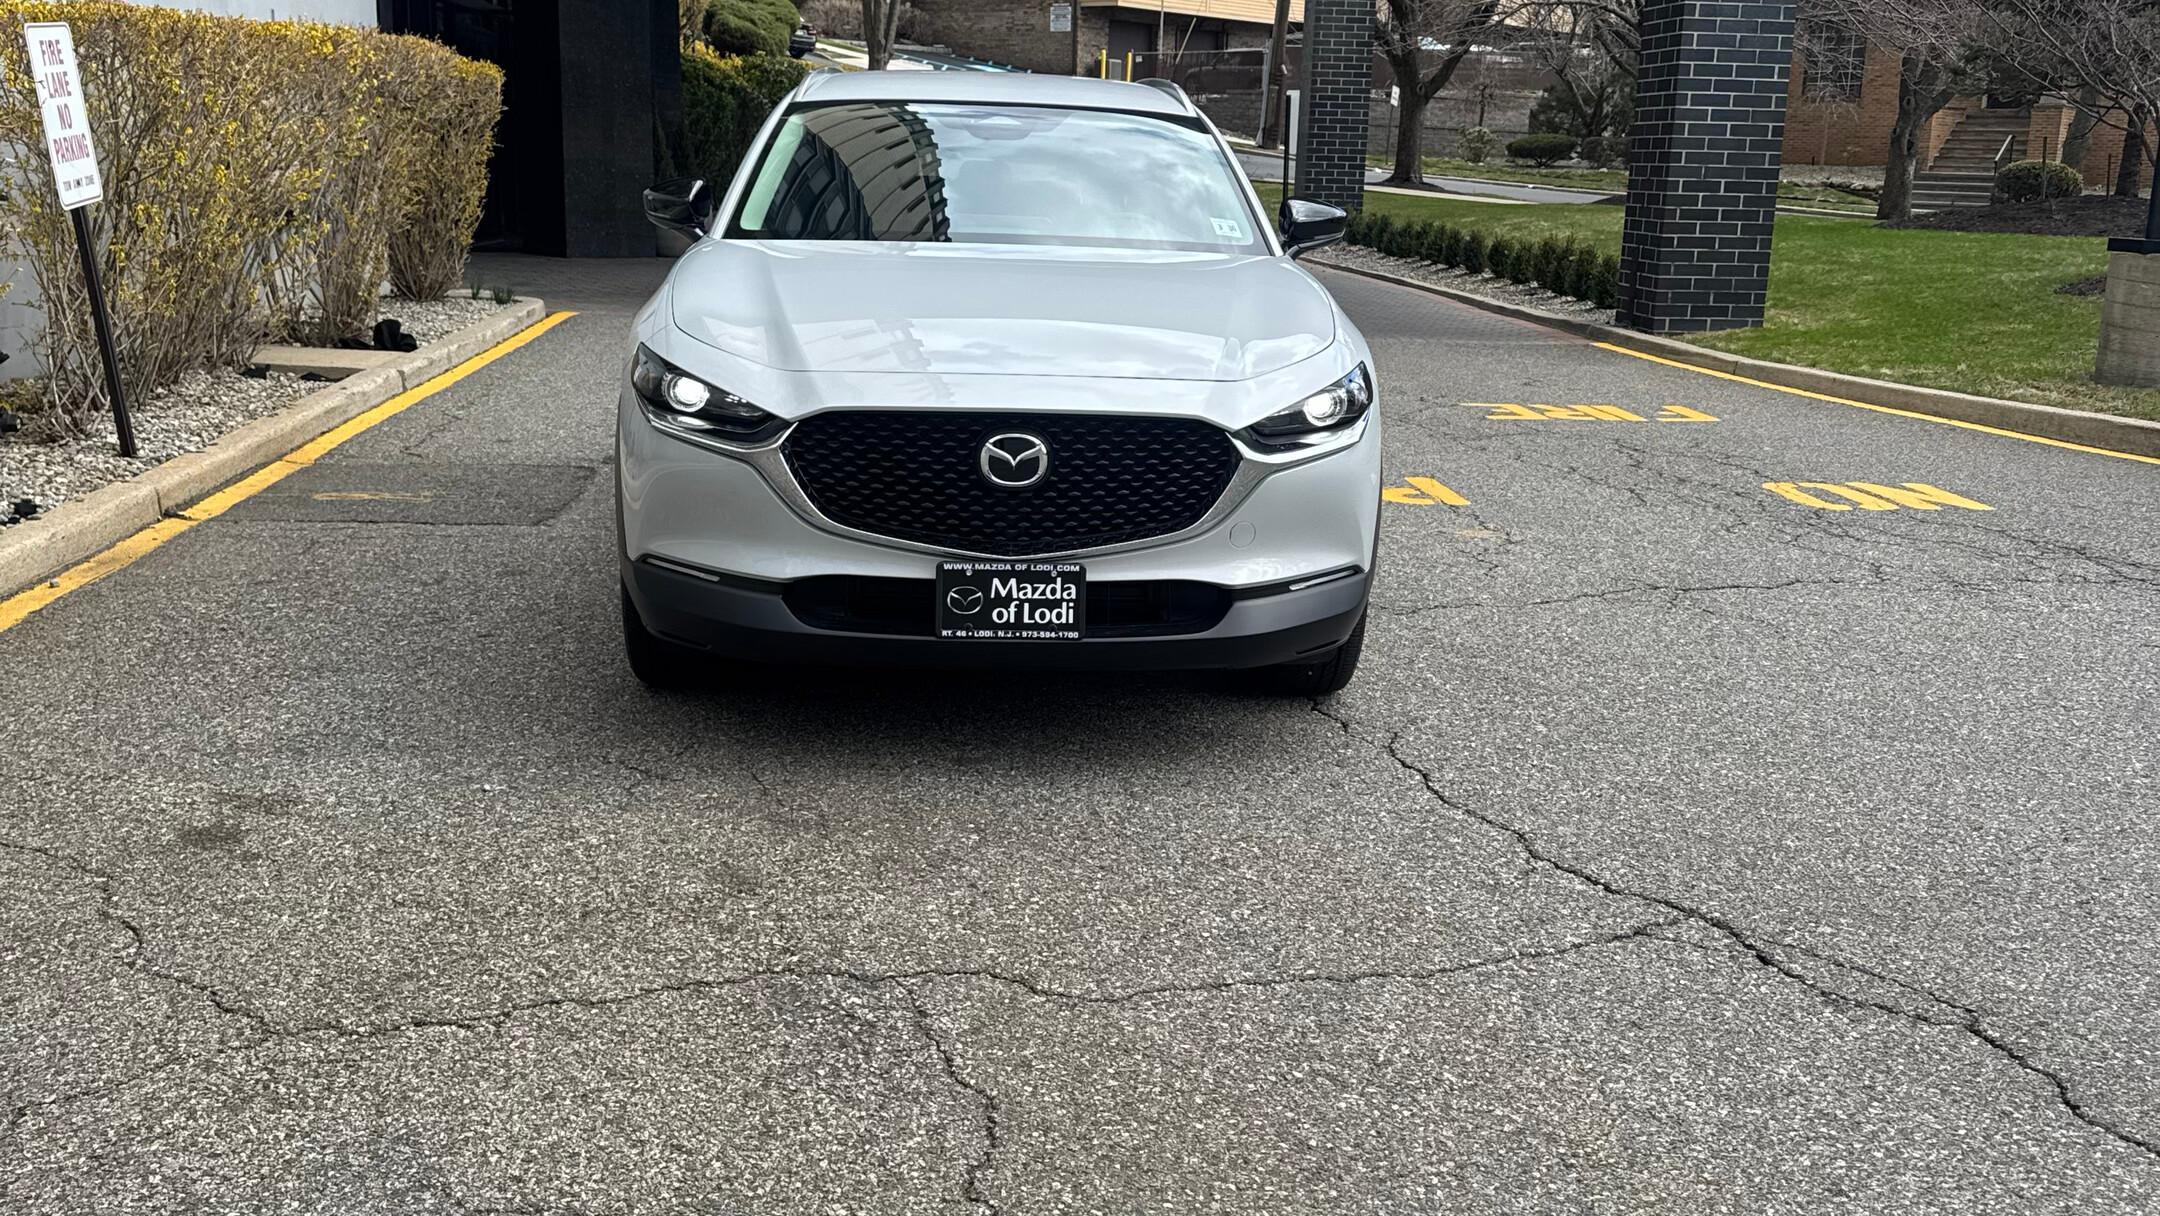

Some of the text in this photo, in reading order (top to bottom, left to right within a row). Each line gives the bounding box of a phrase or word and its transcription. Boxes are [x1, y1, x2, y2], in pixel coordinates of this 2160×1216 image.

[39, 39, 64, 66] FIRE
[45, 71, 71, 99] LANE
[57, 103, 73, 130] NO
[53, 133, 90, 165] PARKING
[1459, 403, 1720, 421] FIRE
[1762, 482, 1996, 510] NO
[1030, 564, 1080, 572] LODI.COM
[991, 577, 1076, 599] Mazda
[992, 601, 1074, 624] of Lodi
